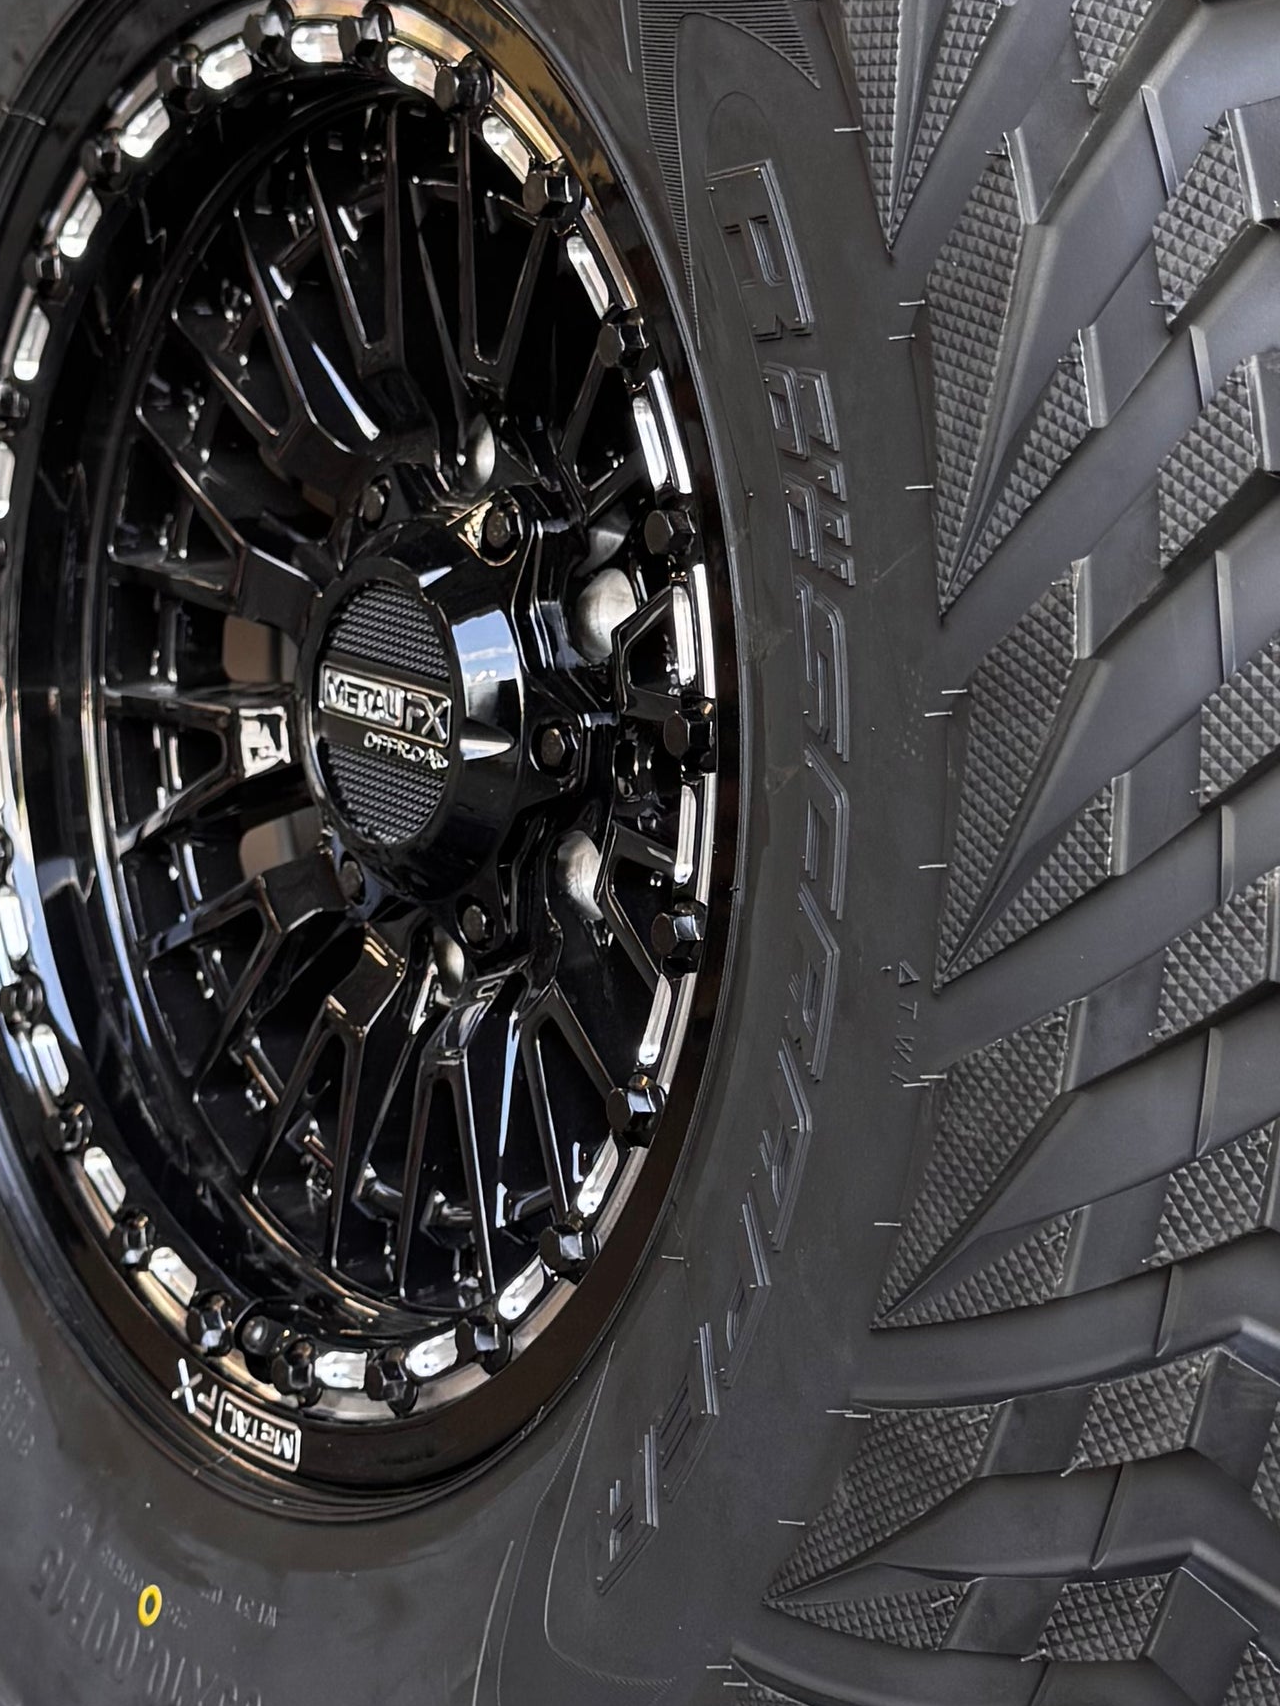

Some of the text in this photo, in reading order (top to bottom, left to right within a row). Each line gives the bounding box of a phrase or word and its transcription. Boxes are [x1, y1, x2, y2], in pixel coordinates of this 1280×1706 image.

[326, 671, 451, 743] METAL FX
[362, 730, 450, 771] OFFROAD
[171, 1357, 295, 1460] METAL FX
